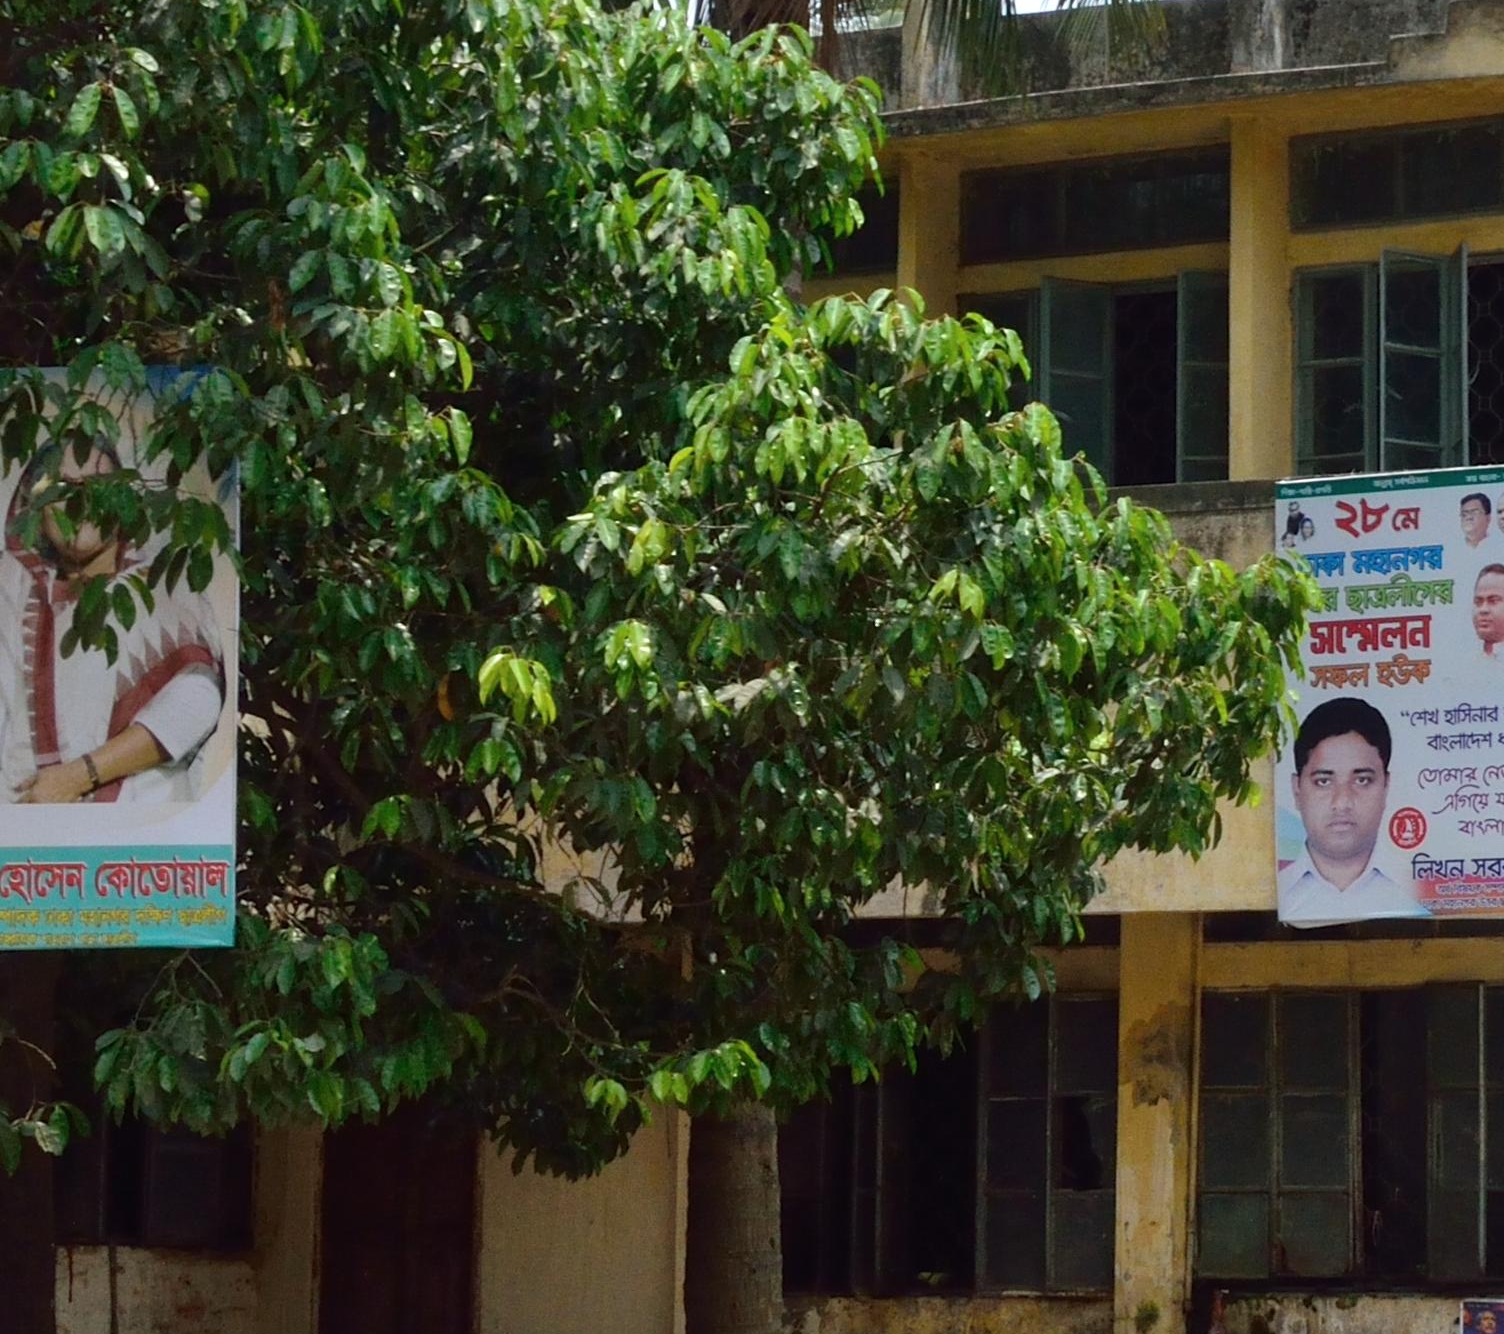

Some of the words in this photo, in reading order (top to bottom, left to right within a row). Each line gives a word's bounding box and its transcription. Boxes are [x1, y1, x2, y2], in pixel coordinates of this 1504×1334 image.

[1334, 498, 1390, 539] ২৮
[1391, 507, 1421, 532] মে
[1302, 552, 1346, 578] াকা
[1351, 545, 1444, 575] মহানগর
[1345, 572, 1455, 615] ছাত্রলীগের
[1309, 615, 1432, 655] সম্মেলন
[1309, 663, 1370, 689] সফল
[1376, 653, 1432, 688] হউক
[1443, 702, 1499, 727] হাসিনার
[1427, 733, 1492, 752] বাংলাদেশ
[1417, 766, 1478, 790] তোমার
[1432, 784, 1490, 815] এগিয়ে
[94, 855, 230, 899] কোতোয়াল
[1411, 852, 1465, 881] লিখন
